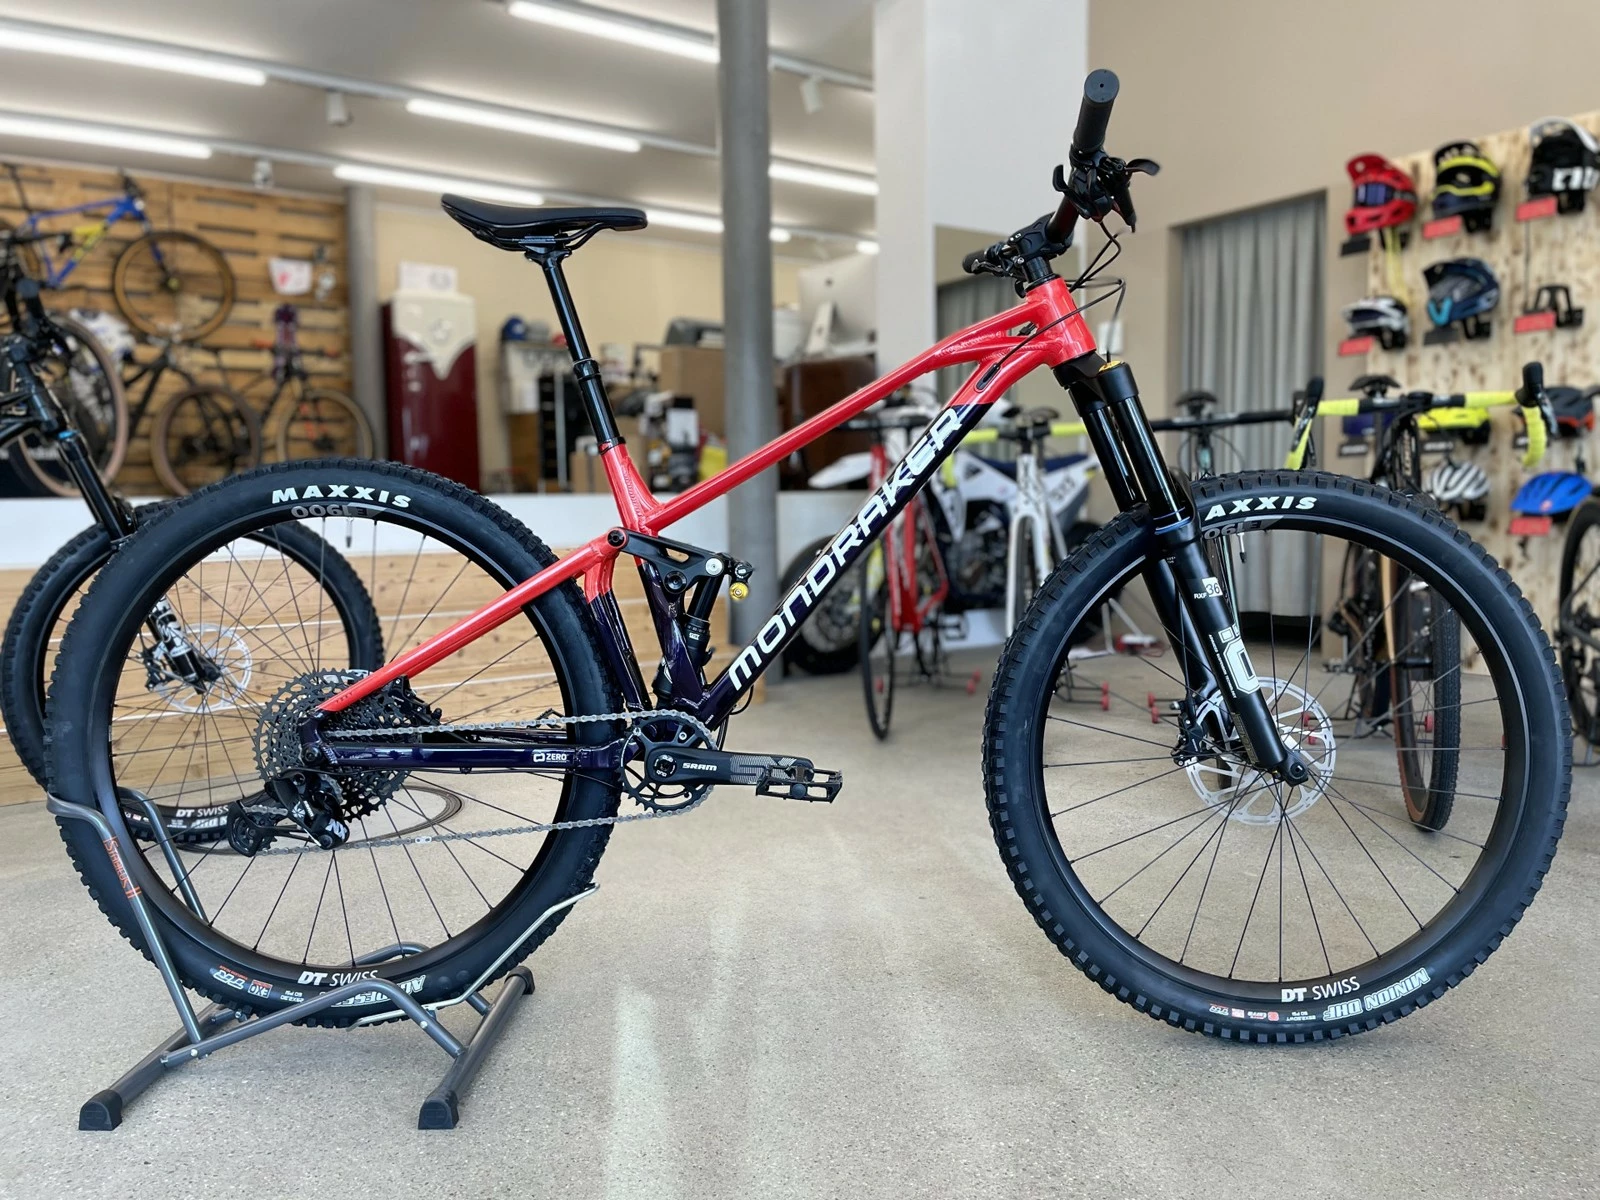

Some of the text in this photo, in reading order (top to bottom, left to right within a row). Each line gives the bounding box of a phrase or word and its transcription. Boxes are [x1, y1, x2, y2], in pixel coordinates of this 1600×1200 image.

[271, 484, 412, 508] MAXXIS
[1204, 496, 1318, 521] AXXIS
[1206, 582, 1221, 595] 36
[546, 753, 568, 762] ZERO
[682, 762, 718, 772] SRAM
[176, 808, 194, 818] DT
[298, 971, 328, 986] DT
[1282, 976, 1361, 1003] DT SWISS
[1323, 969, 1431, 1022] MINION DHF
